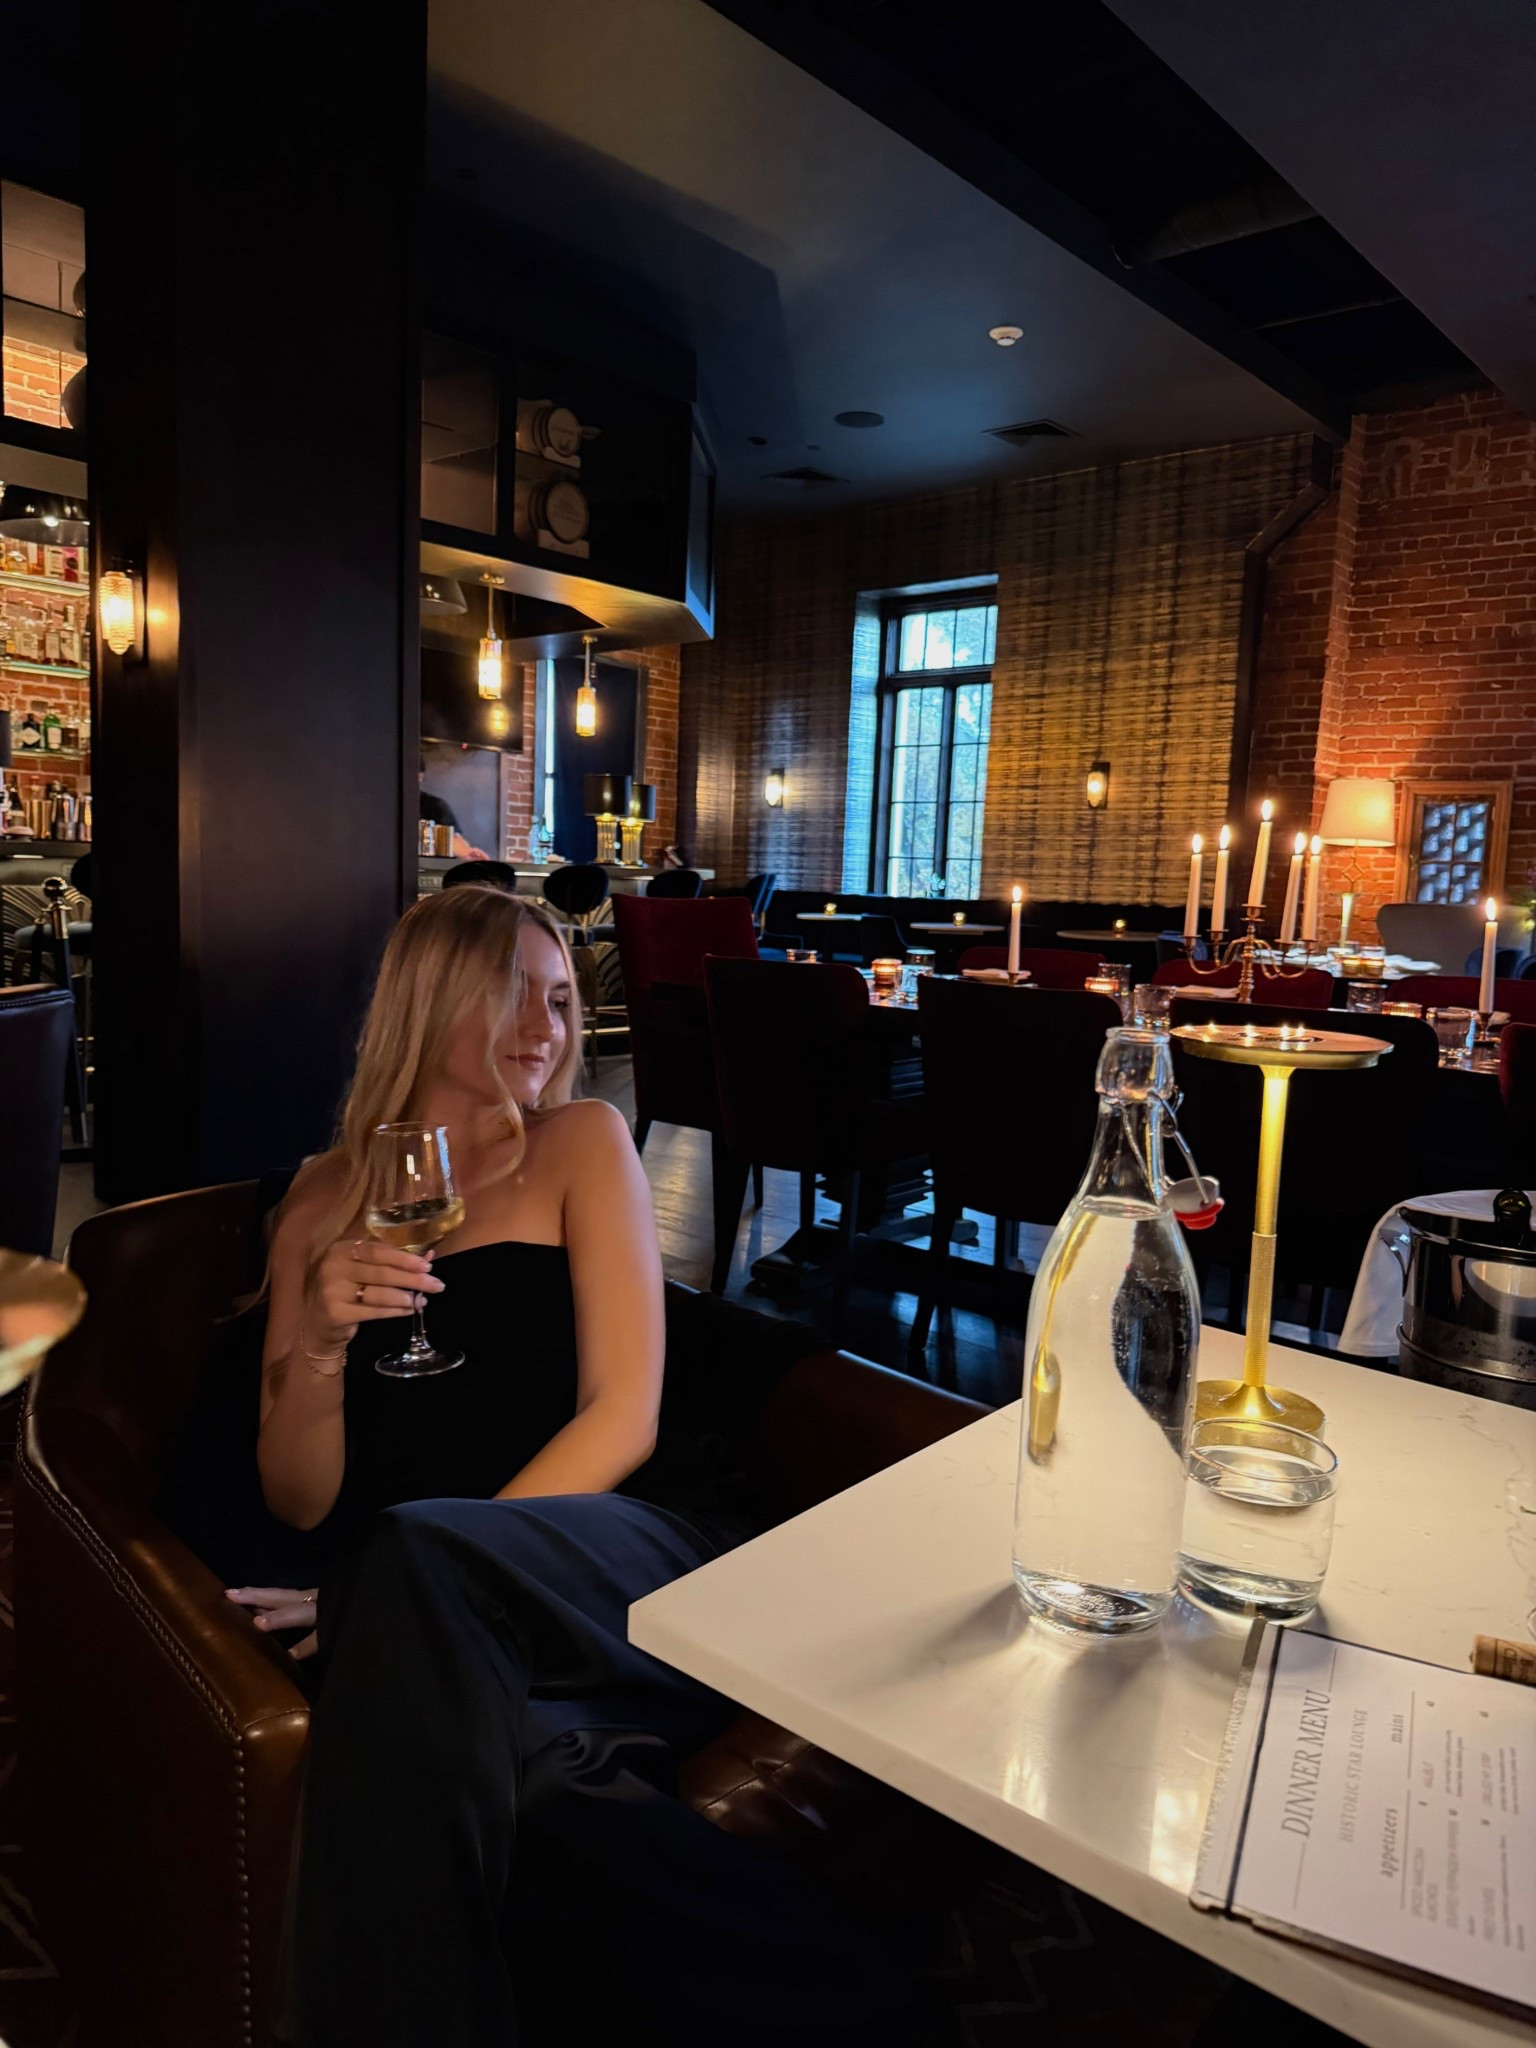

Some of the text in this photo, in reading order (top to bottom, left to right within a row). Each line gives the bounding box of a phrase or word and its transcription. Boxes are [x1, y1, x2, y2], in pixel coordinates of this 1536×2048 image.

[1281, 1690, 1332, 1838] DINNER MENU
[1340, 1709, 1368, 1843] HISTORIC STAR LOUNGE
[1389, 1713, 1403, 1743] mains
[1381, 1808, 1398, 1879] appetizers
